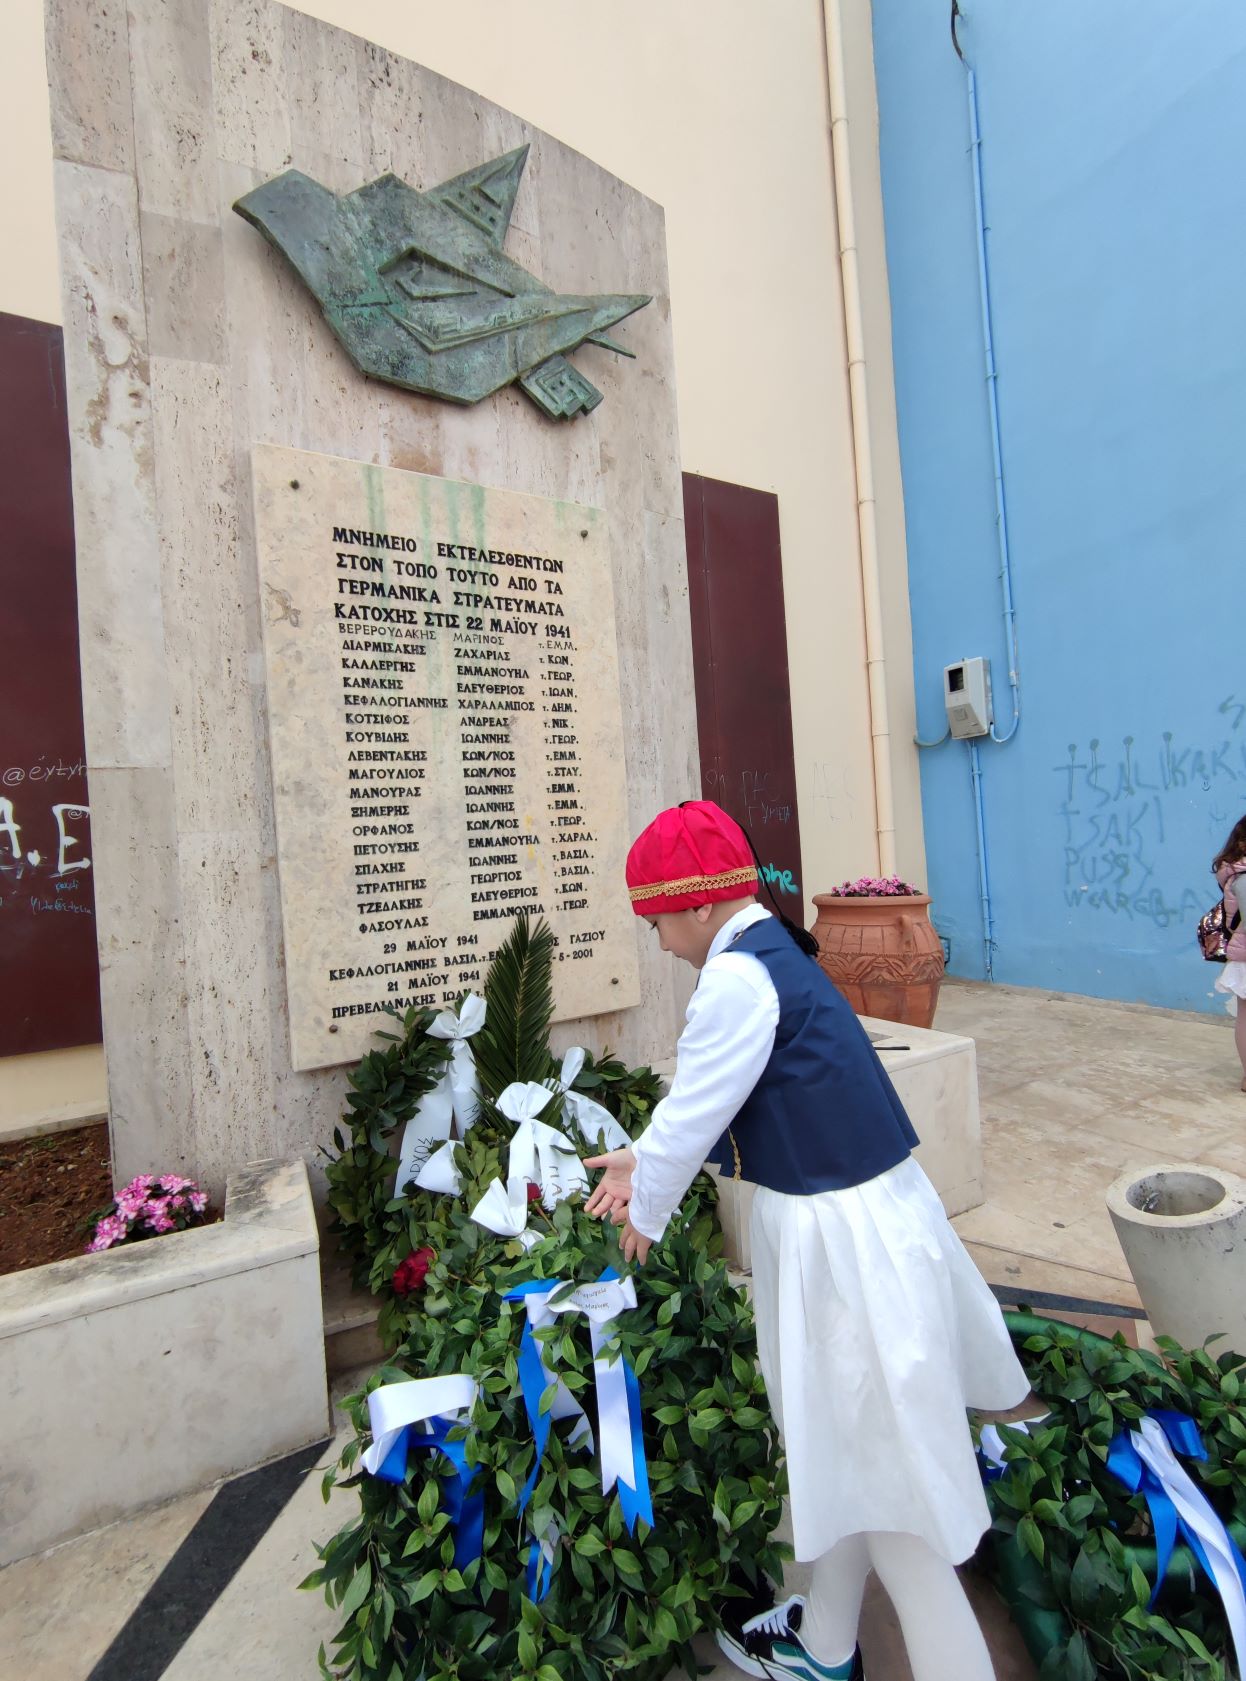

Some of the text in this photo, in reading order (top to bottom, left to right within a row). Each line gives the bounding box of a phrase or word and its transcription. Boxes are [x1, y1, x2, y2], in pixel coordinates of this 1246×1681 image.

[332, 526, 564, 573] ΜΝΗΜΕΙΟ ΕΚΤΕΛΕΣΘΕΝΤΩΝ
[336, 552, 563, 595] ΣΤΟΝ ΤΟΠΟ ΤΟΥΤΟ ΑΠΟ ΤΑ
[338, 578, 564, 617] ΓΕΡΜΑΝΙΚΑ ΣΤΡΑΤΕΥΜΑΤΑ
[334, 603, 571, 639] ΚΑΤΟΧΗΣ ΣΤΙΣ 22 ΜΑΪΟΥ 1941
[338, 622, 437, 640] ΒΕΡΕΡΟΥΔΑΚΗΣ
[453, 633, 505, 646] ΜΑΡΙΝΟΣ
[342, 640, 427, 655] ΔΙΑΡΜΙΣΑΚΗΣ
[454, 648, 511, 661] ΖΑΧΑΡΙΑΣ
[341, 658, 416, 672] ΚΑΛΛΕΡΓΗΣ
[457, 665, 530, 679] ΕΜΜΑΝΟΥΗΛ
[343, 677, 404, 690] ΚΑΝΑΚΗΣ
[457, 683, 525, 695] ΕΛΕΥΘΕΡΙΟΣ
[344, 694, 448, 708] ΚΕΦΑΛΟΓΙΑΝΝΗΣ
[458, 699, 535, 711] ΧΑΡΑΛΑΜΠΟΣ
[345, 713, 410, 725] ΚΟΤΣΙΦΟΣ
[460, 716, 509, 727] ΑΝΔΡΕΑΣ
[345, 731, 410, 743] ΚΟΥΒΙΔΗΣ
[461, 734, 510, 744] ΙΩΑΝΝΗΣ
[348, 751, 428, 761] ΛΕΒΕΝΤΑΚΗΣ
[462, 751, 515, 761] ΚΩΝ/ΝΟΣ
[348, 768, 426, 779] ΜΑΓΟΥΛΙΟΣ
[463, 768, 517, 778] ΚΩΝ/ΝΟΣ
[349, 787, 421, 799] ΜΑΝΟΥΡΑΣ
[465, 785, 514, 796] ΙΩΑΝΝΗΣ
[350, 805, 410, 818] ΞΗΜΕΡΗΣ
[466, 802, 515, 814] ΙΩΑΝΝΗΣ
[352, 823, 414, 836] ΟΡΦΑΝΟΣ
[466, 819, 519, 831] ΚΩΝ/ΝΟΣ
[353, 842, 420, 856] ΠΕΤΟΥΣΗΣ
[468, 835, 540, 849] ΕΜΜΑΝΟΥΗΛ
[355, 862, 406, 876] ΣΠΑΧΗΣ
[469, 854, 518, 867] ΙΩΑΝΝΗΣ
[356, 879, 427, 895] ΣΤΡΑΤΗΓΗΣ
[470, 871, 522, 885] ΓΕΩΡΓΙΟΣ
[357, 898, 423, 915] ΤΖΕΔΑΚΗΣ
[470, 887, 538, 903] ΕΛΕΥΘΕΡΙΟΣ
[359, 916, 429, 934] ΦΑΣΟΥΛΑΣ
[473, 904, 544, 921] ΕΜΜΑΝΟΥΗΛ
[383, 934, 478, 954] 29 ΜΑΪΟΥ 1941
[569, 930, 606, 944] ΓΑΖΙΟΥ
[329, 958, 438, 981] ΚΕΦΑΛΟΓΙΑΝΝΗΣ
[387, 970, 480, 992] 21 ΜΑΪΟΥ 1941
